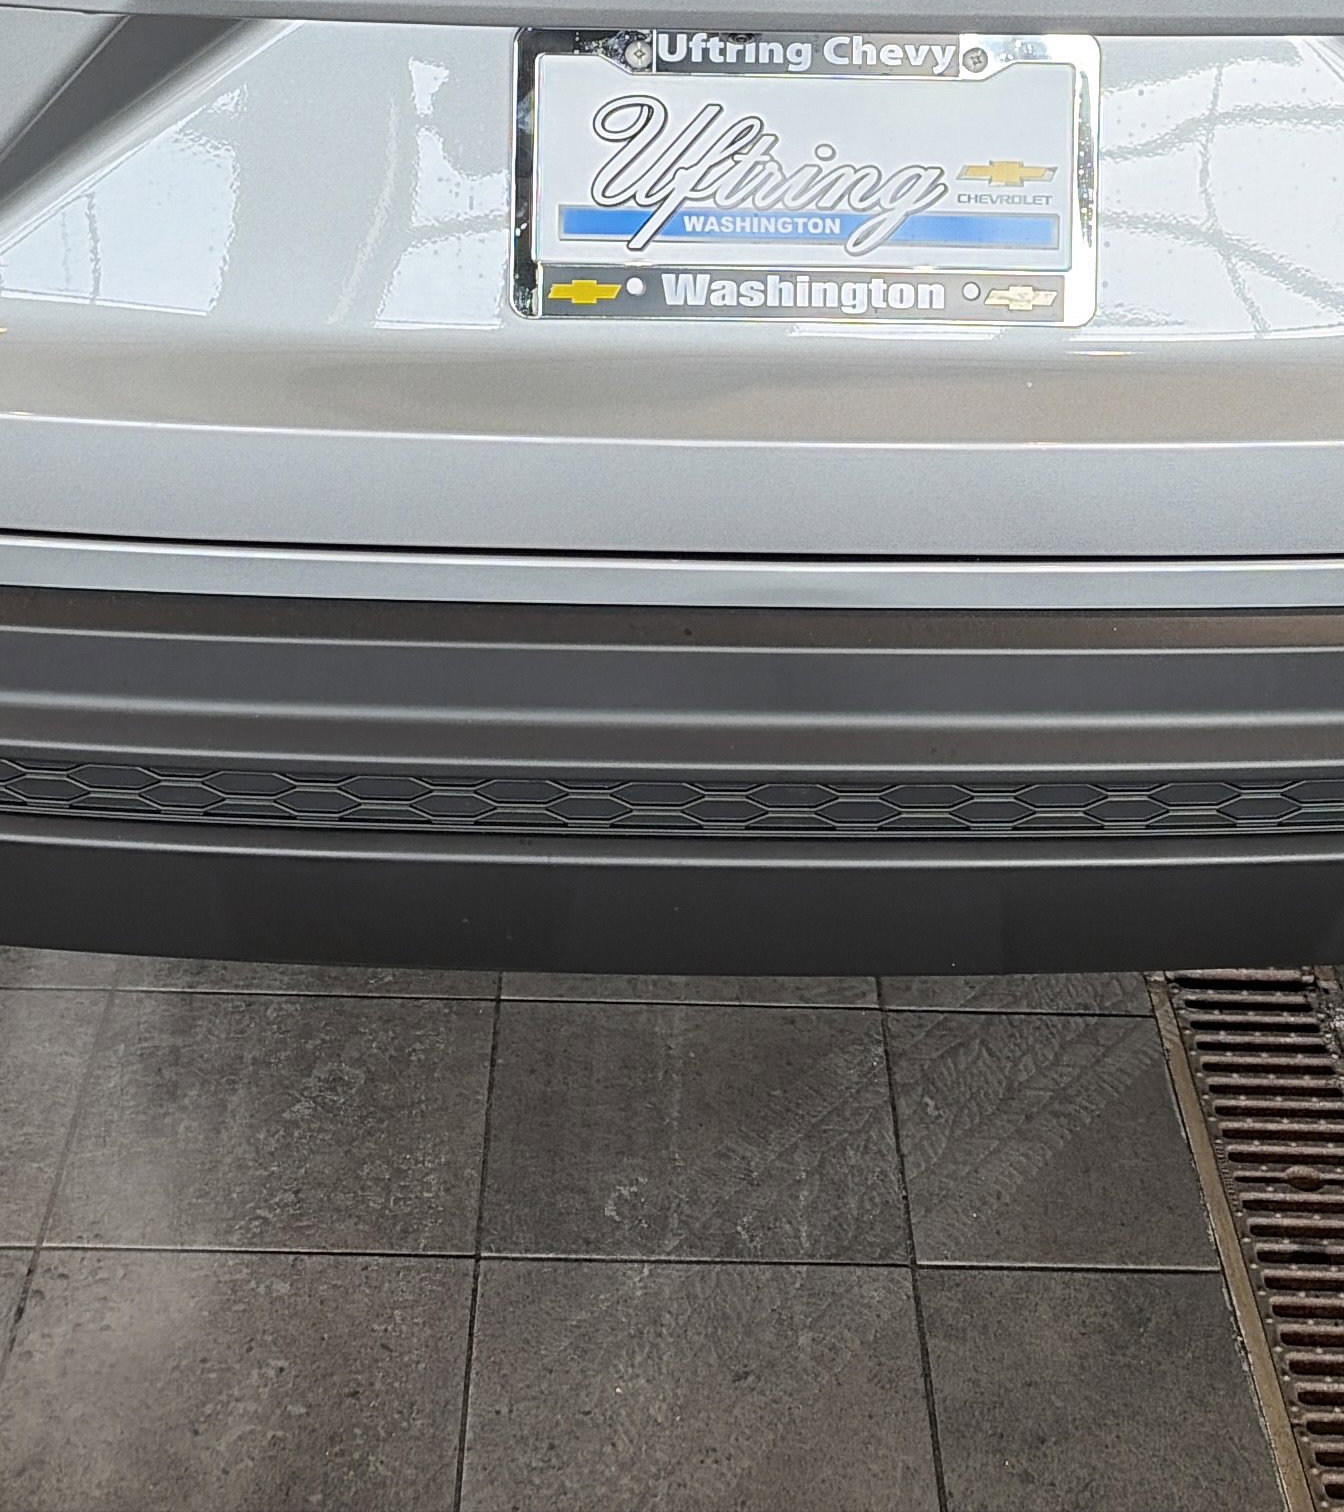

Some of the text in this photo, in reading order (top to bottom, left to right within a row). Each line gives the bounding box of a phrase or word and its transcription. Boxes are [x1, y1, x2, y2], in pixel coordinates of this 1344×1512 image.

[657, 34, 956, 75] Uftring Chevy
[591, 94, 949, 256] Uftring
[956, 193, 1053, 206] CHEVROLET
[683, 214, 841, 235] WASHINGTON
[661, 273, 946, 315] Washington
